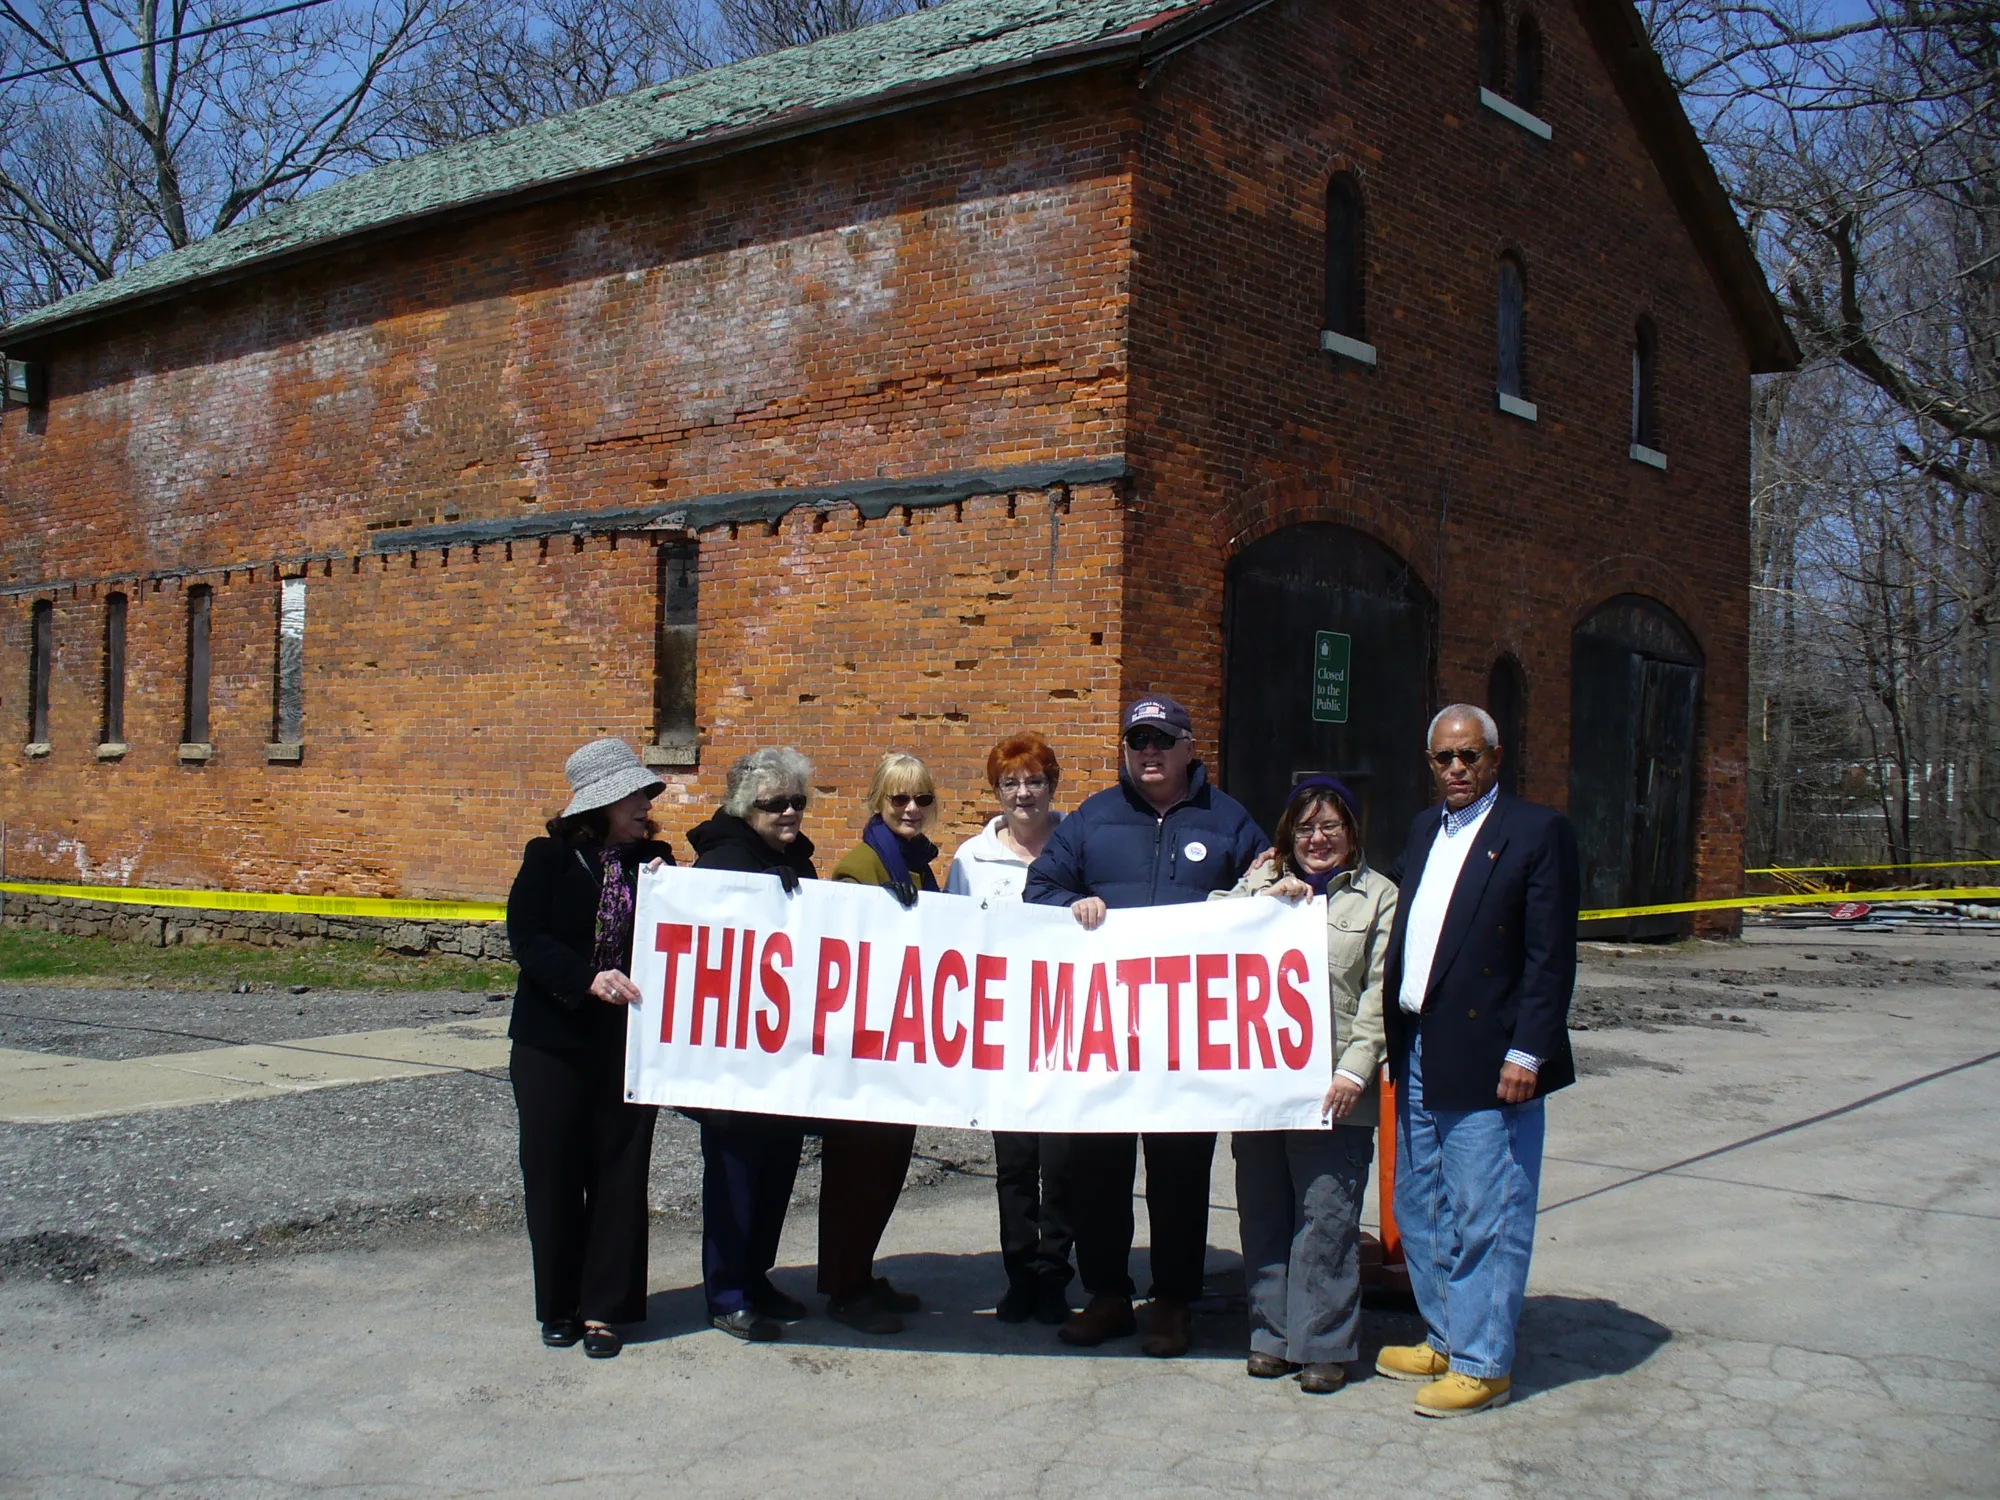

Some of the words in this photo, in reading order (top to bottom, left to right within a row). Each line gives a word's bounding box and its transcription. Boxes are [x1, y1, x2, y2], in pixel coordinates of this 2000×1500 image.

[1317, 667, 1344, 681] Closed
[1317, 684, 1326, 695] to
[1327, 683, 1340, 696] the
[1316, 698, 1341, 711] Public
[655, 922, 793, 1054] THIS
[812, 936, 1008, 1069] PLACE
[1028, 948, 1314, 1073] MATTERS
